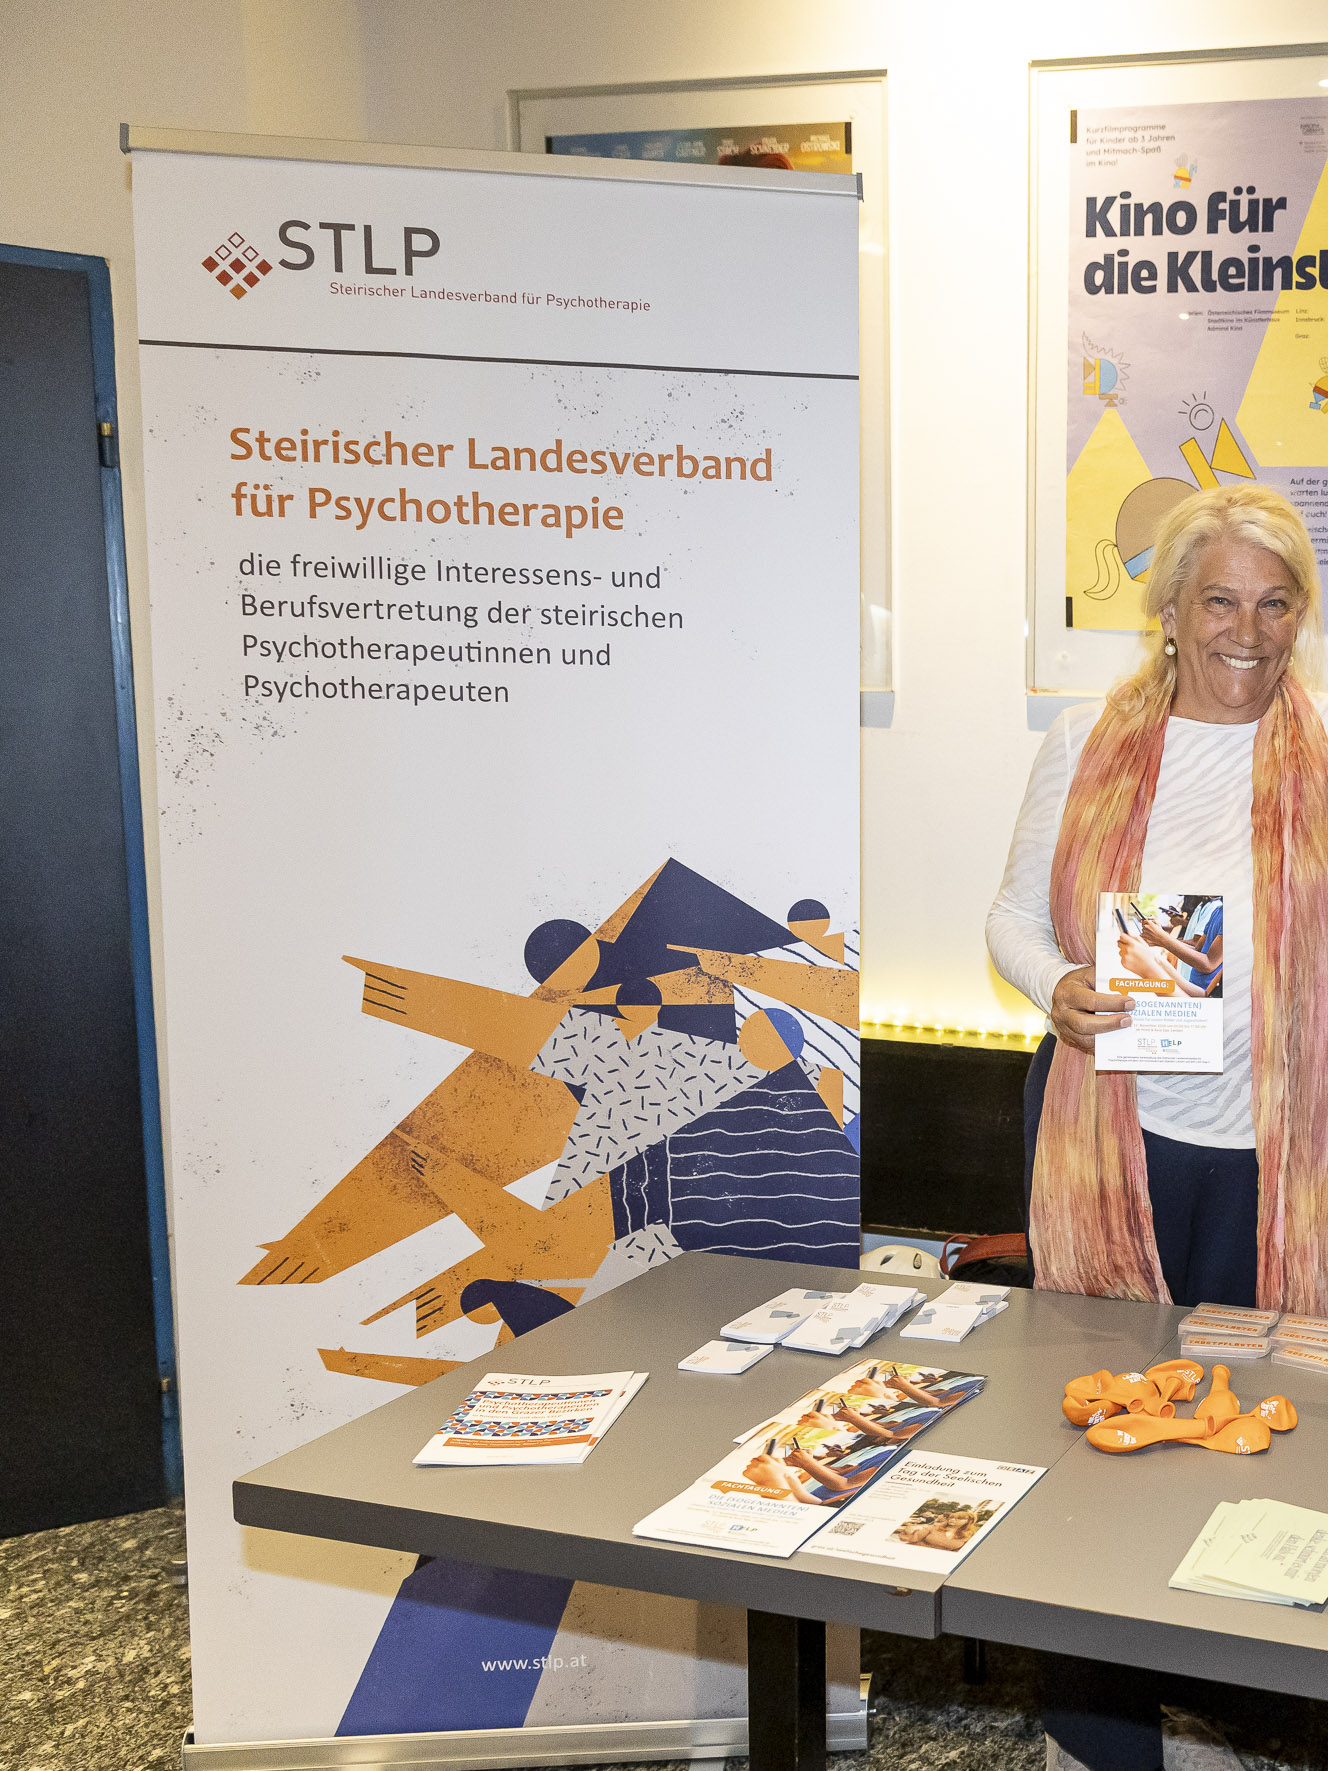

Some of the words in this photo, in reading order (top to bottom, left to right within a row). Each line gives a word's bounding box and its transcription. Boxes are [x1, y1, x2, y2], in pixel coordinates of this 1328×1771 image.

[1087, 124, 1166, 133] Kurzfilmprogramme
[1100, 136, 1125, 144] Kinder
[1104, 146, 1161, 155] Mitmach-Spaß
[1085, 191, 1197, 237] Kino
[1207, 185, 1287, 234] für
[278, 219, 440, 276] STLP
[1084, 249, 1157, 295] die
[330, 282, 406, 297] Steirischer
[411, 286, 516, 304] Landesverband
[522, 292, 541, 305] für
[546, 294, 650, 313] Psychotherapie
[229, 427, 453, 468] Steirischer
[468, 437, 773, 482] Landesverband
[231, 482, 294, 517] für
[308, 487, 624, 539] Psychotherapie
[239, 553, 281, 578] die
[291, 554, 426, 586] freiwillige
[437, 559, 601, 588] Interessens-
[611, 566, 661, 589] und
[241, 594, 478, 627] Berufsvertretung
[487, 601, 531, 625] der
[540, 604, 683, 629] steirischen
[243, 635, 551, 666] Psychotherapeutinnen
[562, 643, 611, 666] und
[244, 674, 510, 706] Psychotherapeuten
[1116, 980, 1168, 988] FACHTAGUNG:
[1136, 1001, 1202, 1009] SOGENANNTEN)
[502, 1403, 599, 1411] Psychotherapeuten
[898, 1467, 916, 1477] Tag
[943, 1473, 1002, 1487] Seelischen
[905, 1461, 960, 1474] Einladung
[721, 1482, 783, 1495] FACHTAGUNG:
[890, 1475, 955, 1488] Gesundheit
[482, 1654, 587, 1671] www.stlp.at
